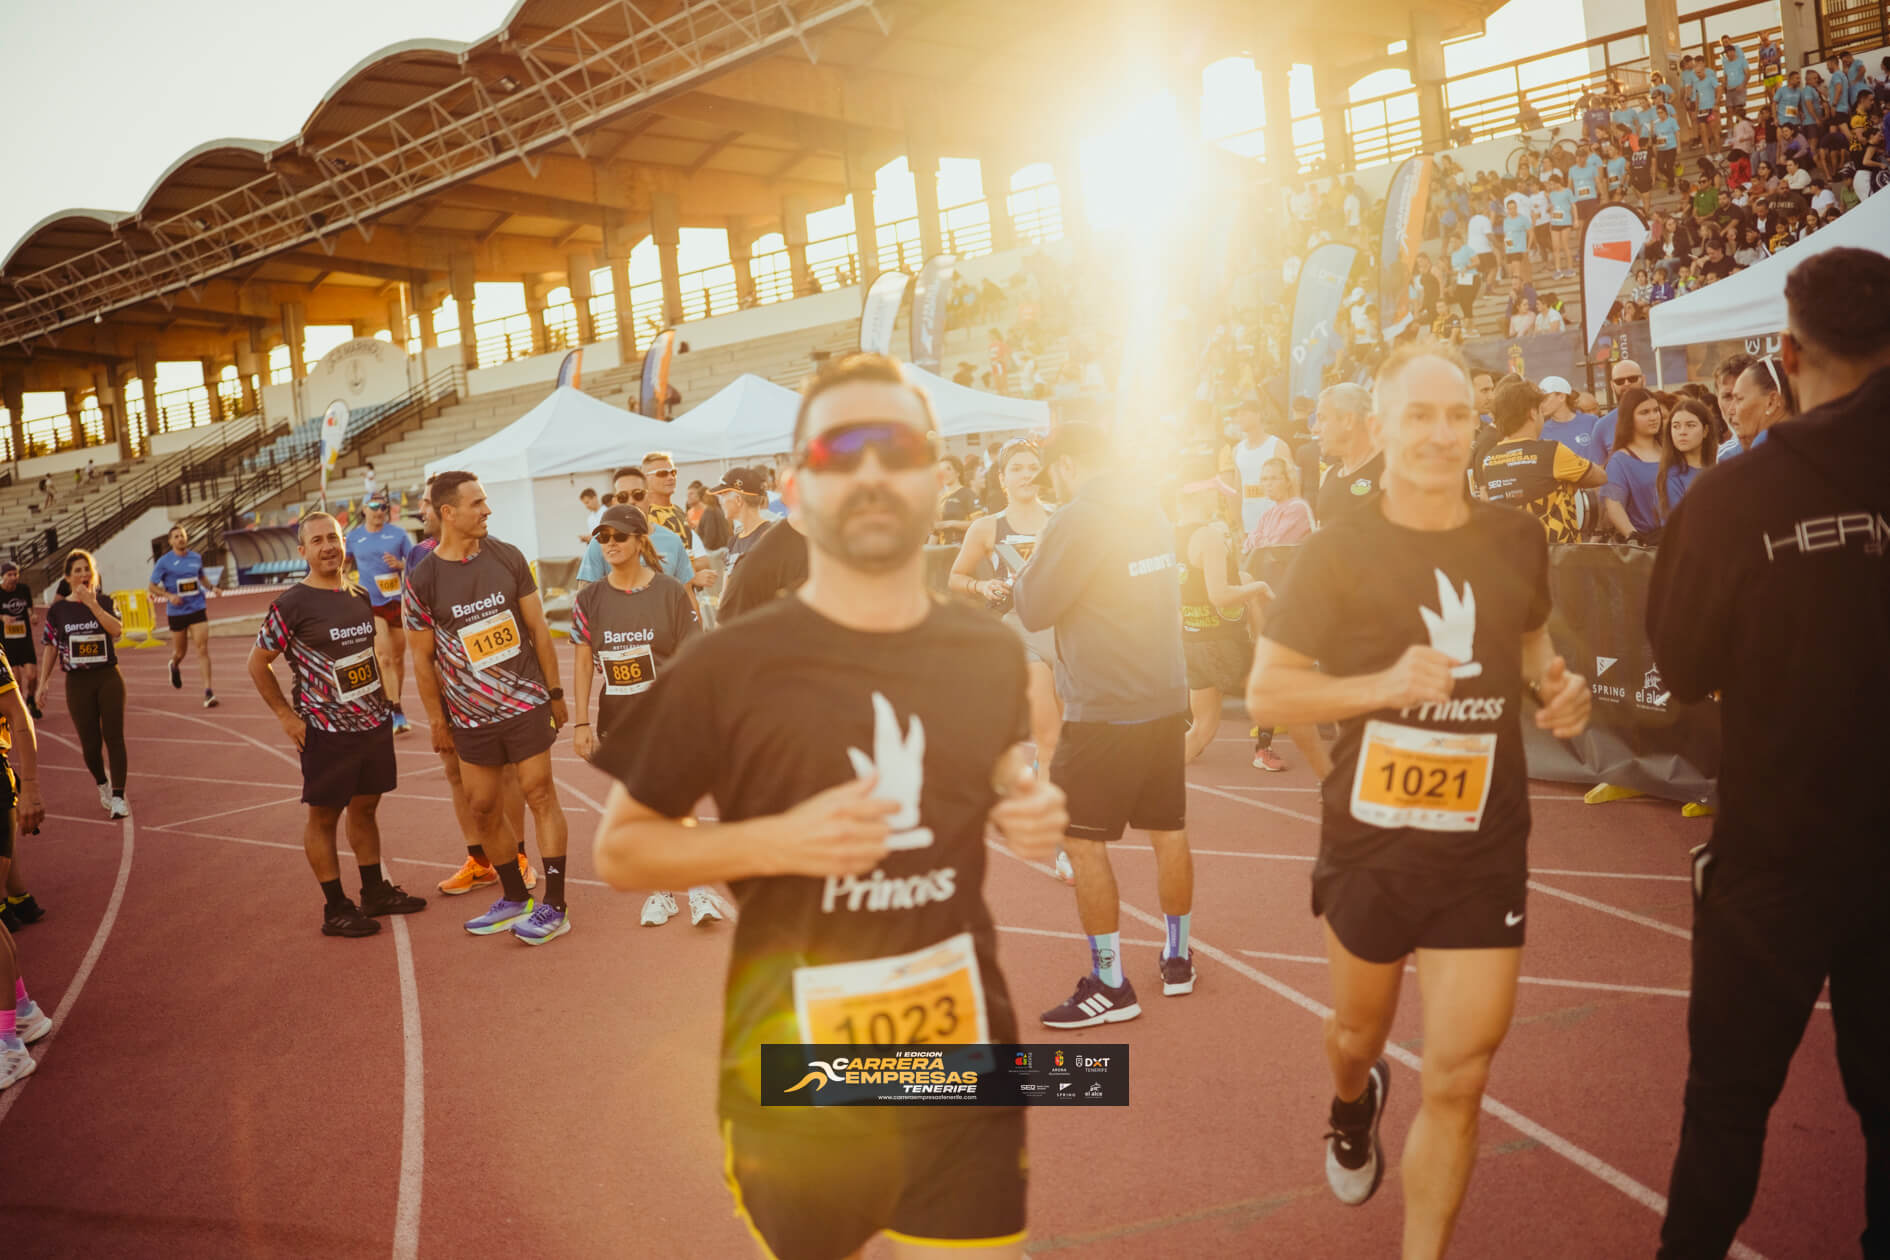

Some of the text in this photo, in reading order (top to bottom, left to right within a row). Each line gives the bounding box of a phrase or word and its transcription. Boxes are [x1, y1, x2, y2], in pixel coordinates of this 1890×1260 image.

[451, 591, 505, 619] Barceló
[64, 620, 99, 633] Barceló
[329, 621, 373, 641] Barceló
[604, 628, 655, 644] Barceló
[79, 643, 99, 655] 562
[473, 627, 513, 653] 1183
[348, 664, 373, 685] 903
[613, 663, 641, 681] 886
[1592, 683, 1625, 698] SPRING
[1635, 688, 1645, 703] el
[1380, 761, 1468, 799] 1021
[834, 995, 959, 1048] 1023
